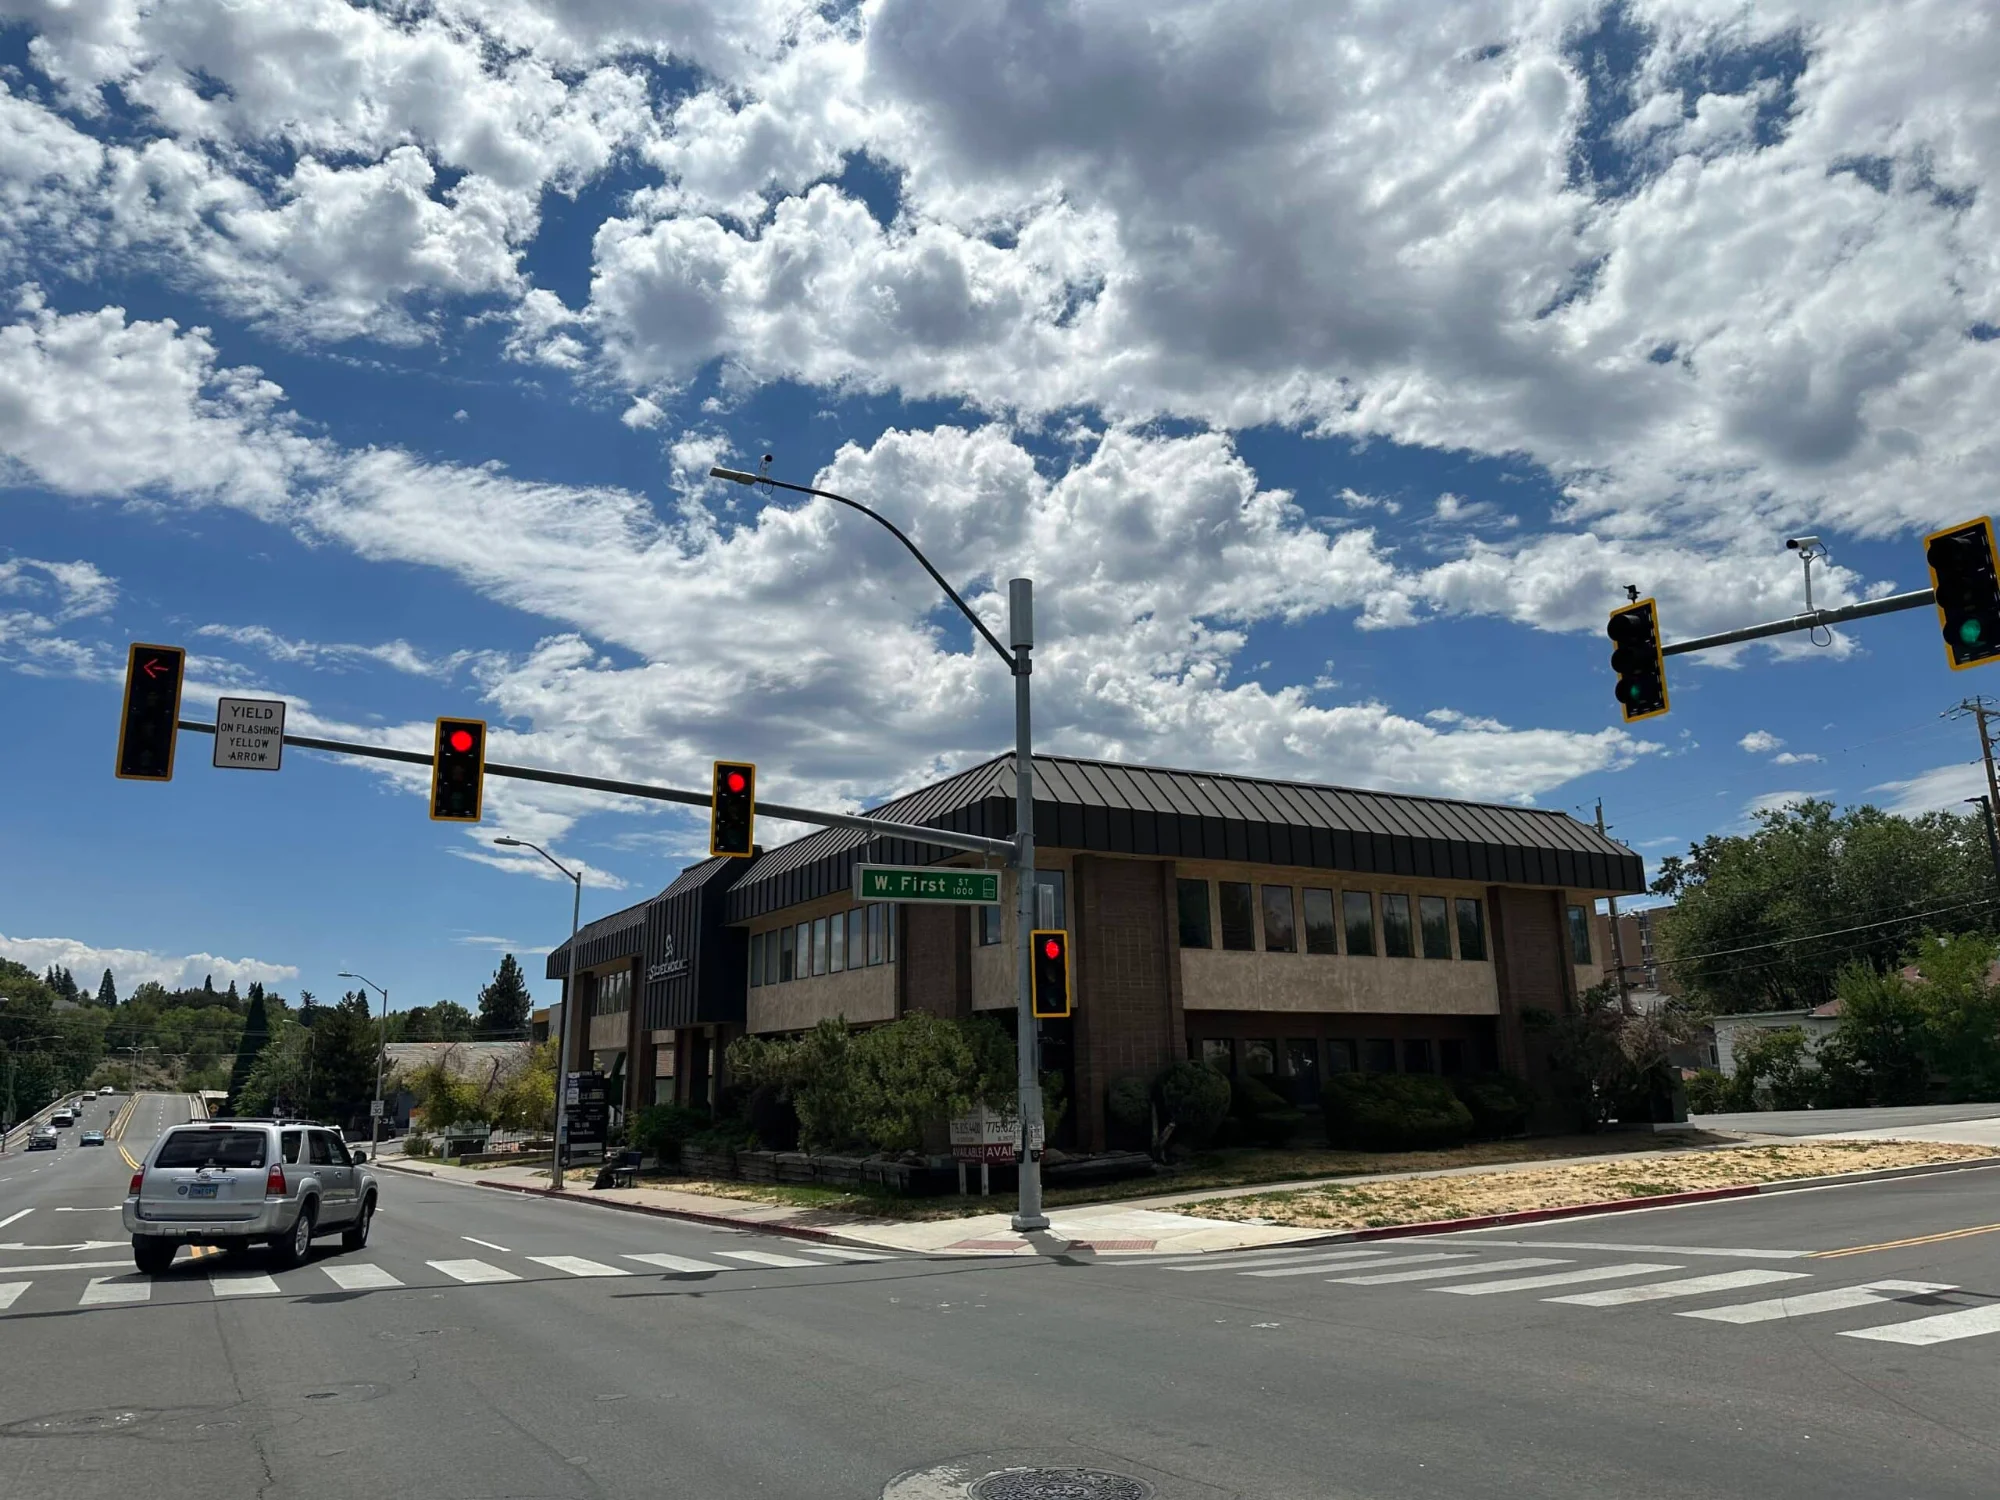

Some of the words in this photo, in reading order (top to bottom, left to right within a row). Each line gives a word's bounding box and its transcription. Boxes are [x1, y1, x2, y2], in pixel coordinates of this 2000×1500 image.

[231, 706, 273, 719] YIELD
[220, 722, 234, 732] ON
[236, 723, 280, 736] FLASHING
[229, 737, 269, 748] YELLOW
[229, 751, 266, 762] ARROW
[874, 875, 893, 891] W.
[901, 876, 946, 893] First
[958, 878, 969, 886] ST
[953, 887, 974, 895] 1000
[952, 1146, 983, 1158] AVAILABLE
